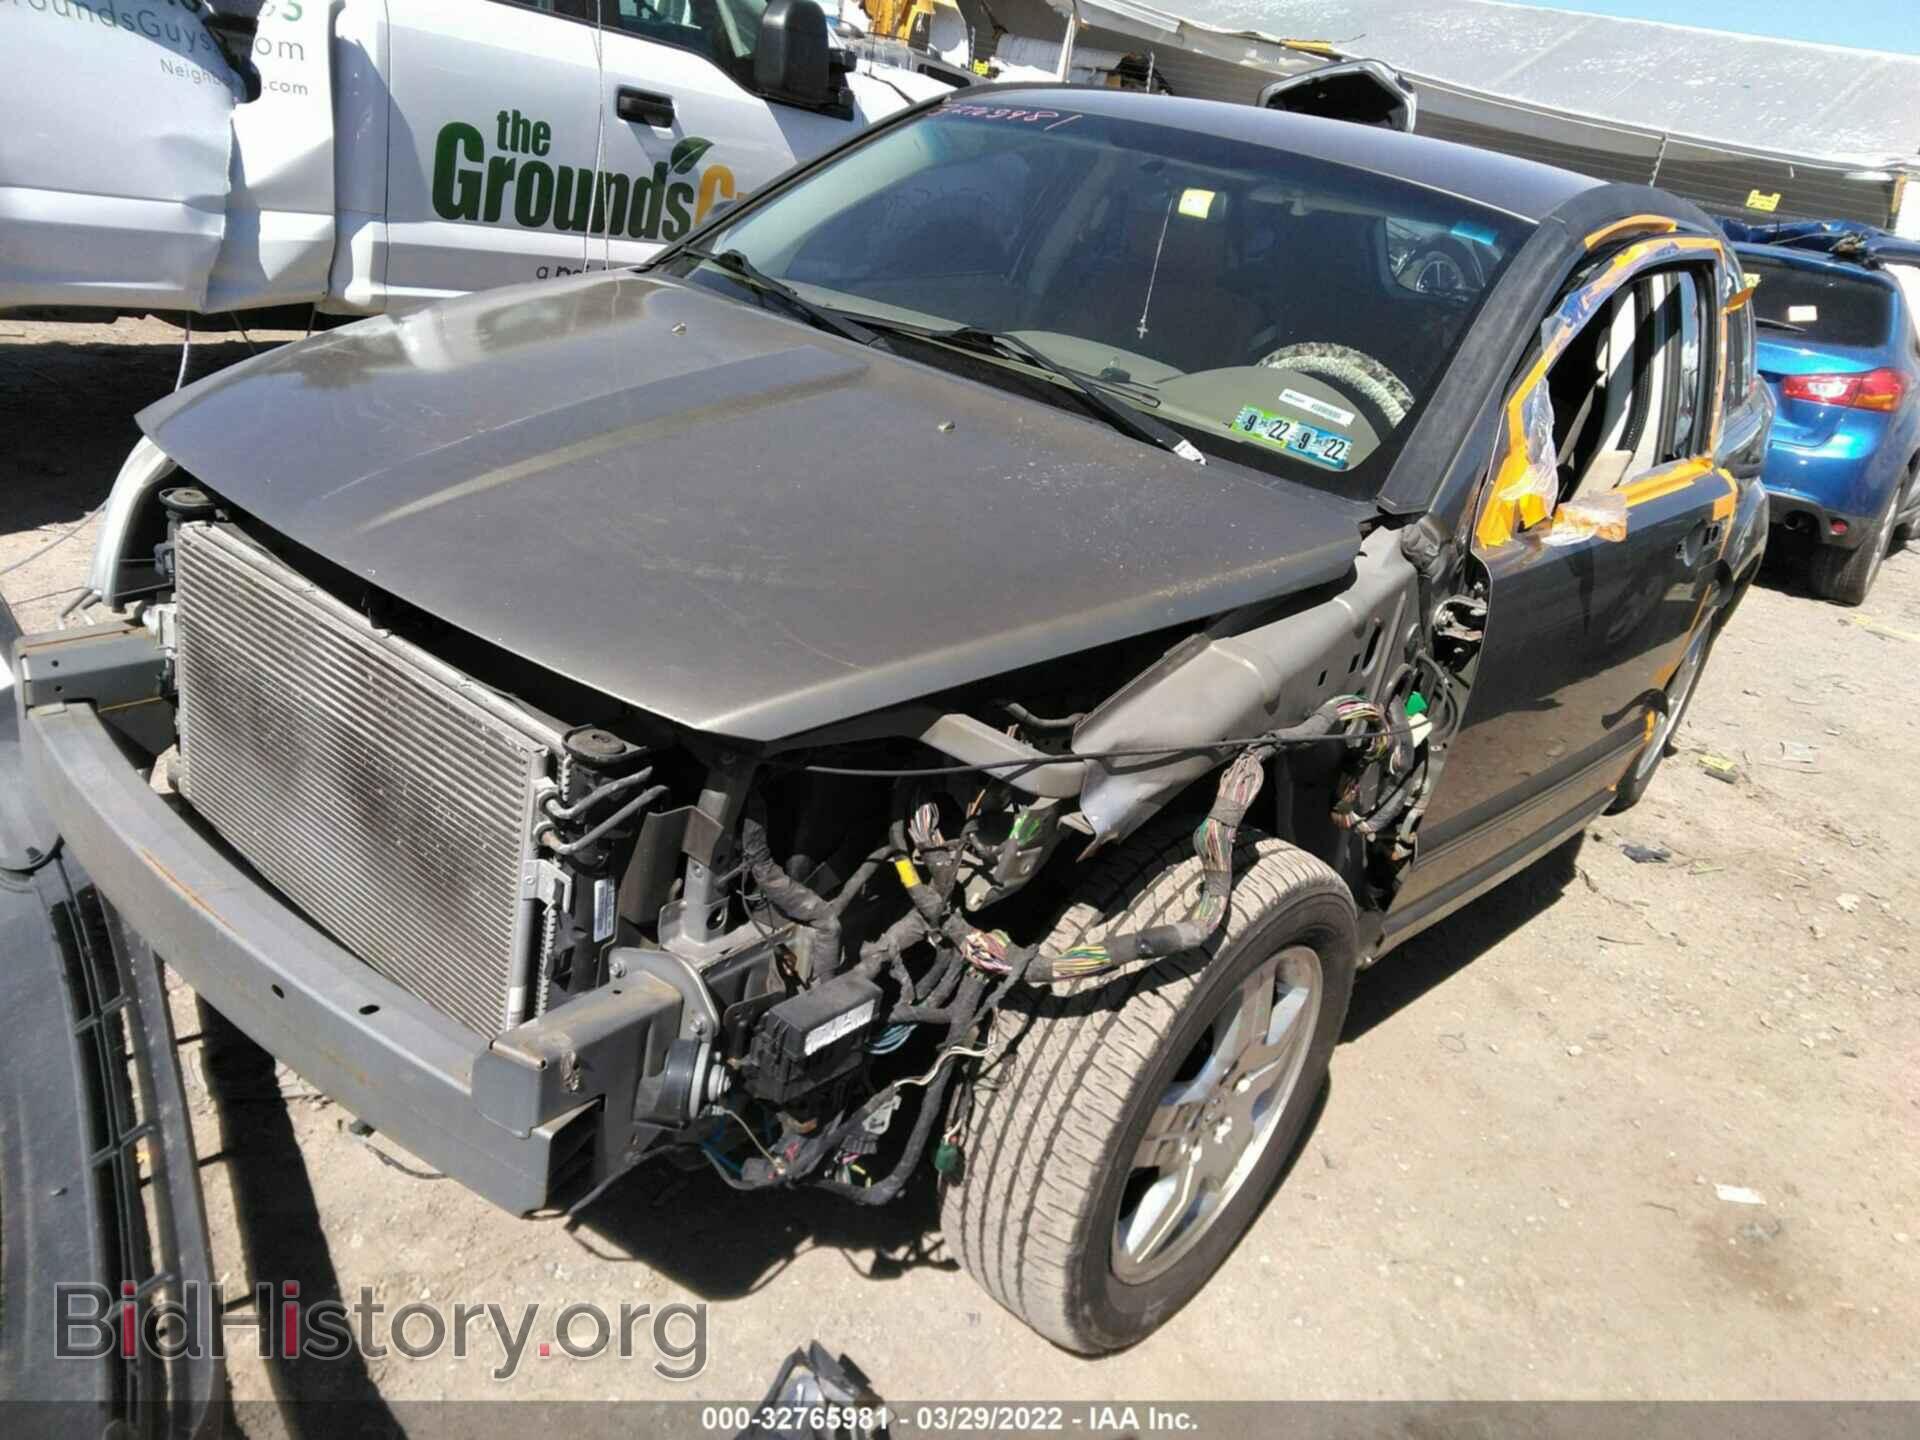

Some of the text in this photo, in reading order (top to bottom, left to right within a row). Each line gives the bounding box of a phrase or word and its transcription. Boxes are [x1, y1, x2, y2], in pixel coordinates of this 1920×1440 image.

[255, 36, 304, 61] om
[497, 109, 551, 156] the
[432, 121, 694, 242] Grounds
[536, 266, 549, 279] a
[1244, 415, 1290, 441] 9 22
[1298, 432, 1345, 460] 9 22
